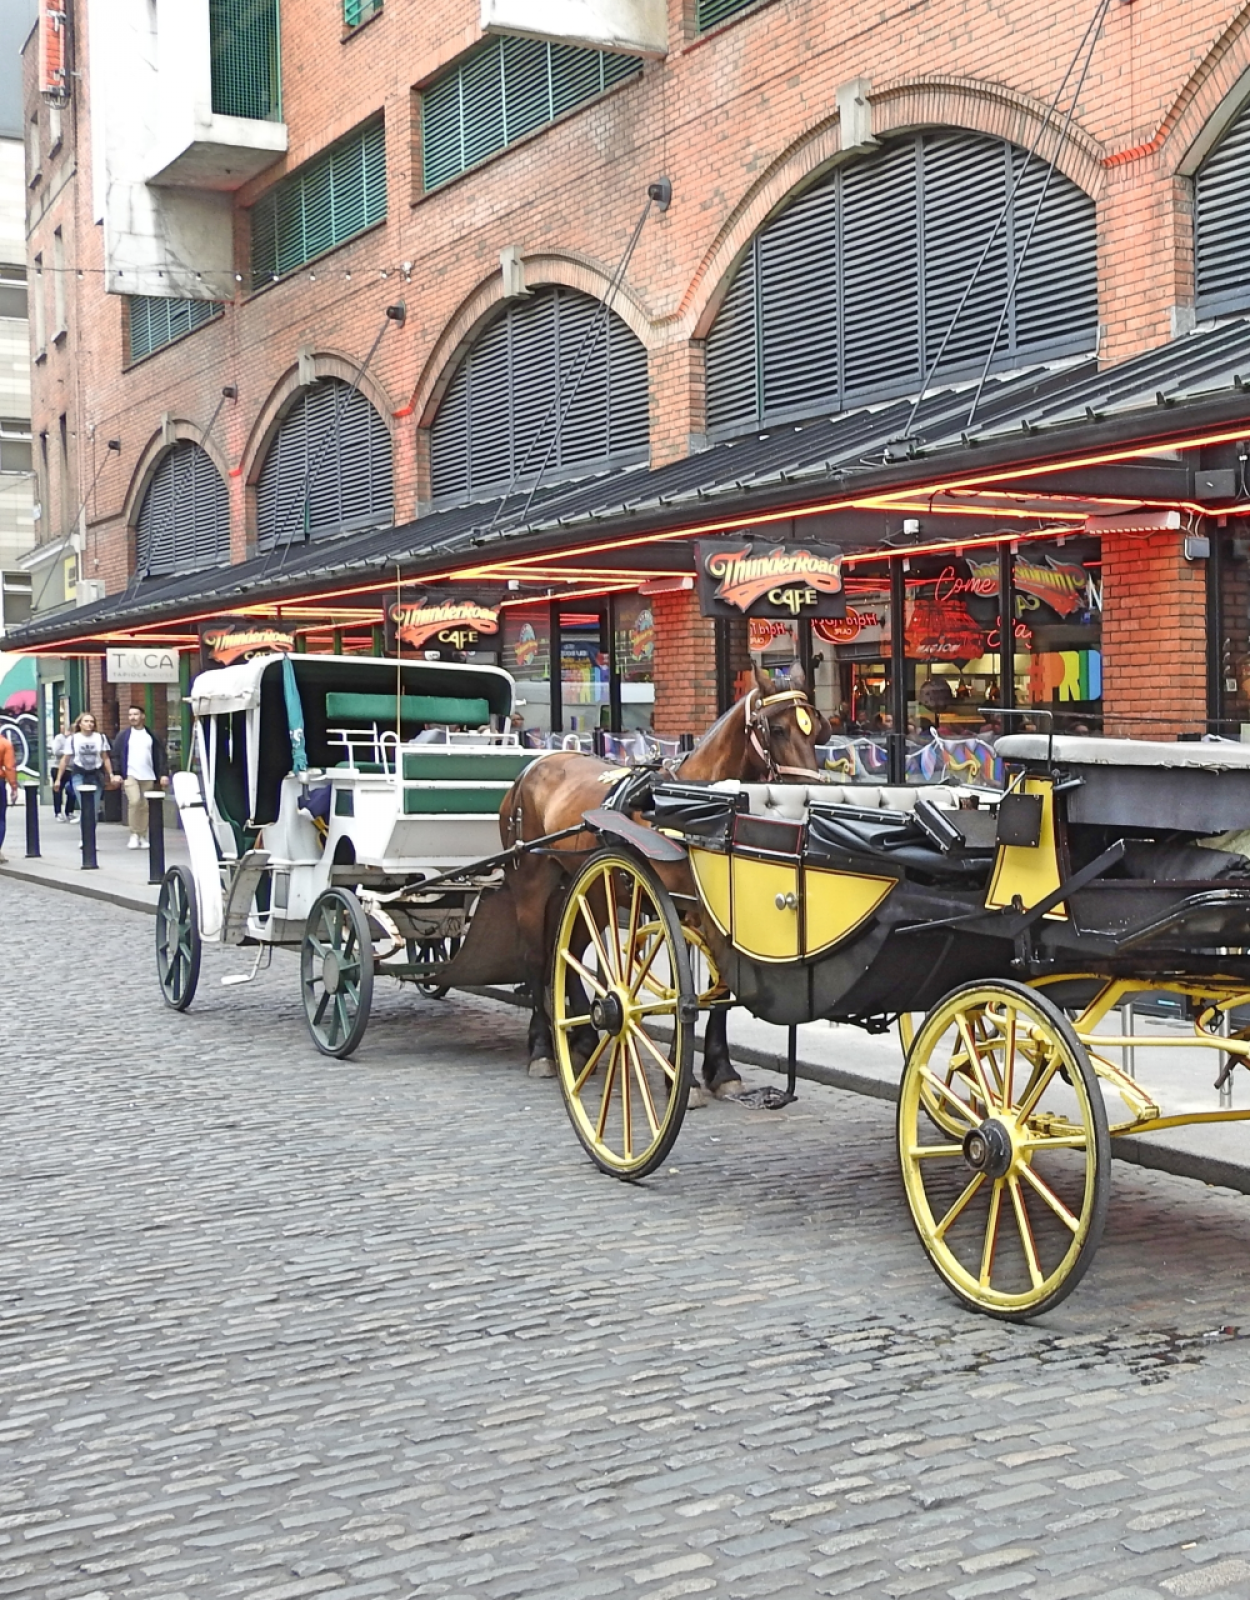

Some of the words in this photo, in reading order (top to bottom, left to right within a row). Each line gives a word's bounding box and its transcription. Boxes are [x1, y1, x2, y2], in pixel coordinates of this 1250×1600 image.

[935, 566, 996, 602] Come
[768, 589, 819, 615] CAFE
[438, 630, 479, 649] CAFE
[1027, 650, 1103, 702] #PRID
